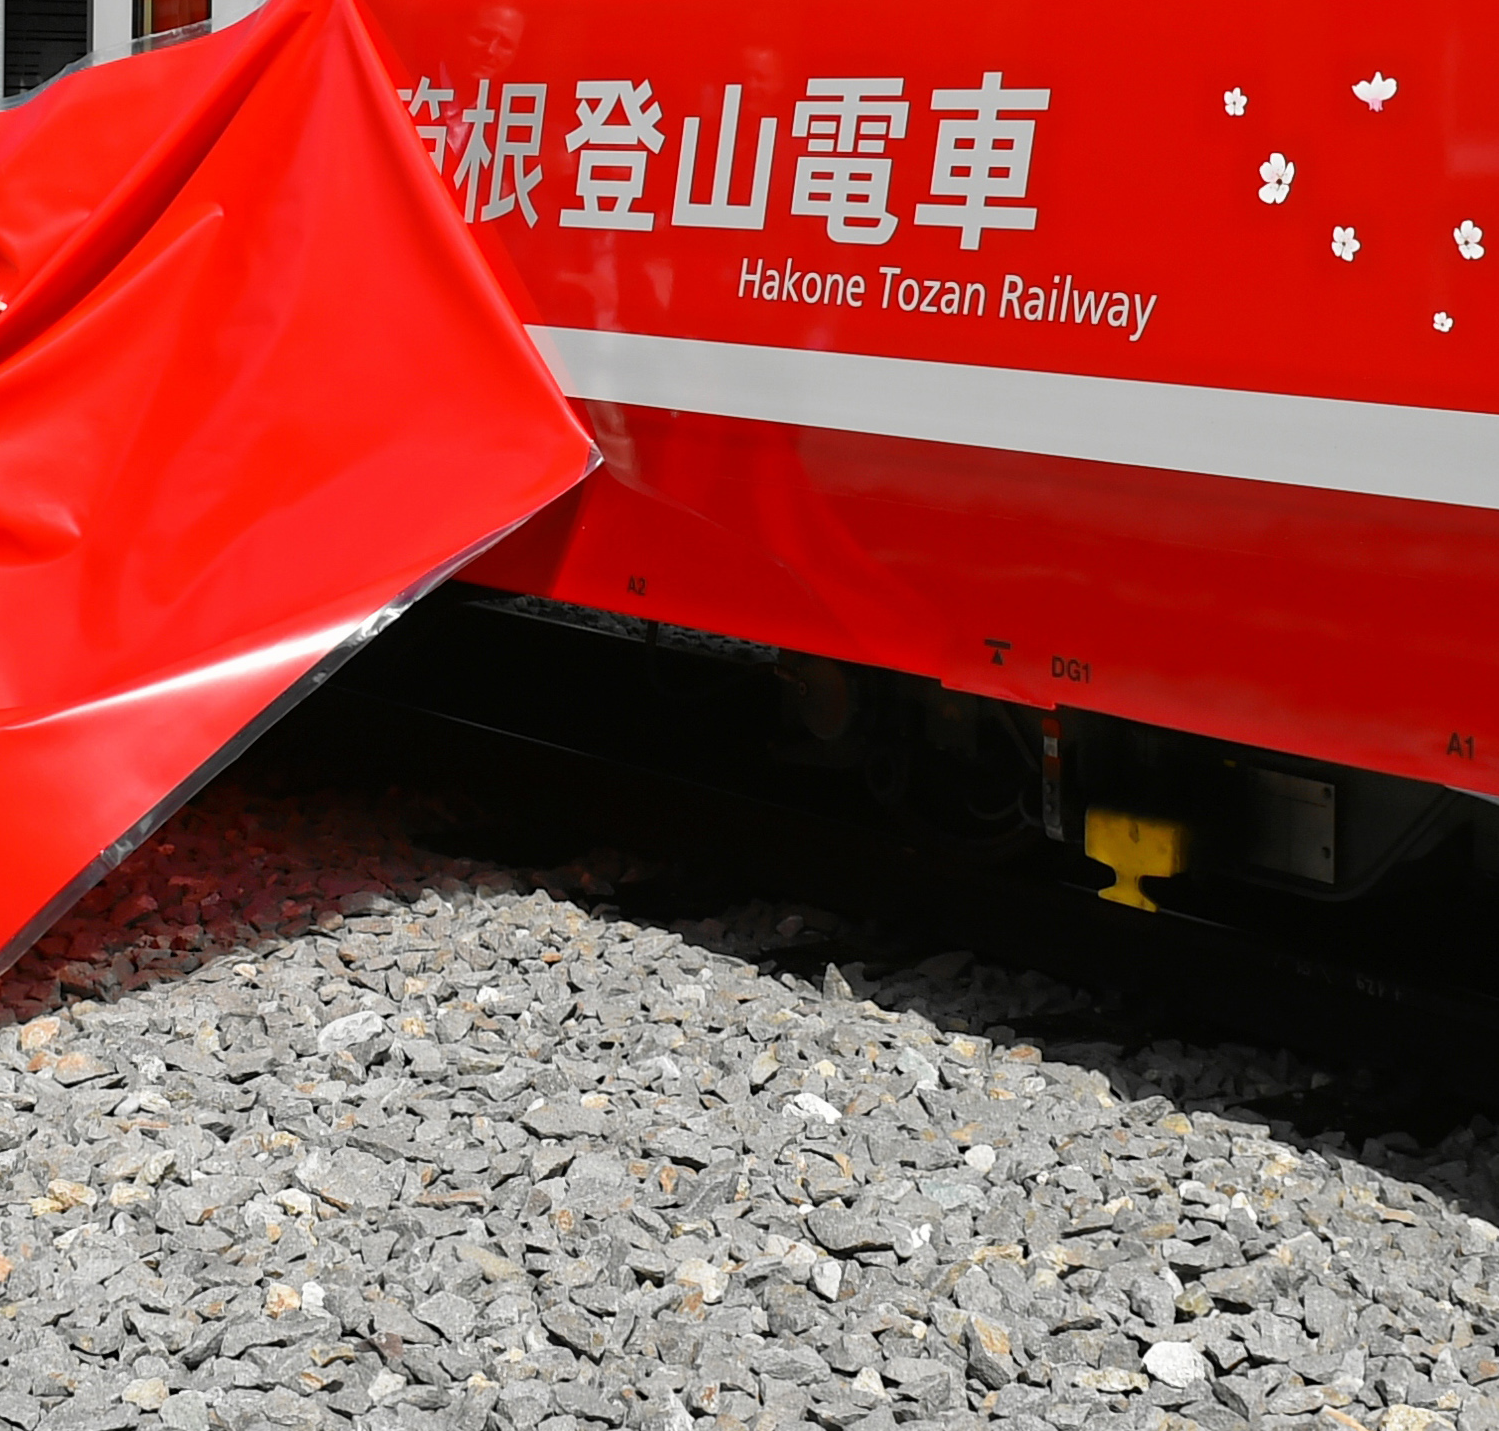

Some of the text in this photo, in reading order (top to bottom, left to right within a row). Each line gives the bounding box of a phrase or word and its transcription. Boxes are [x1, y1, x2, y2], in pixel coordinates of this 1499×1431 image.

[738, 257, 1158, 343] Hakone Tozan Railway
[626, 574, 647, 597] A2
[1051, 655, 1090, 685] DG1
[1446, 731, 1474, 760] A1
